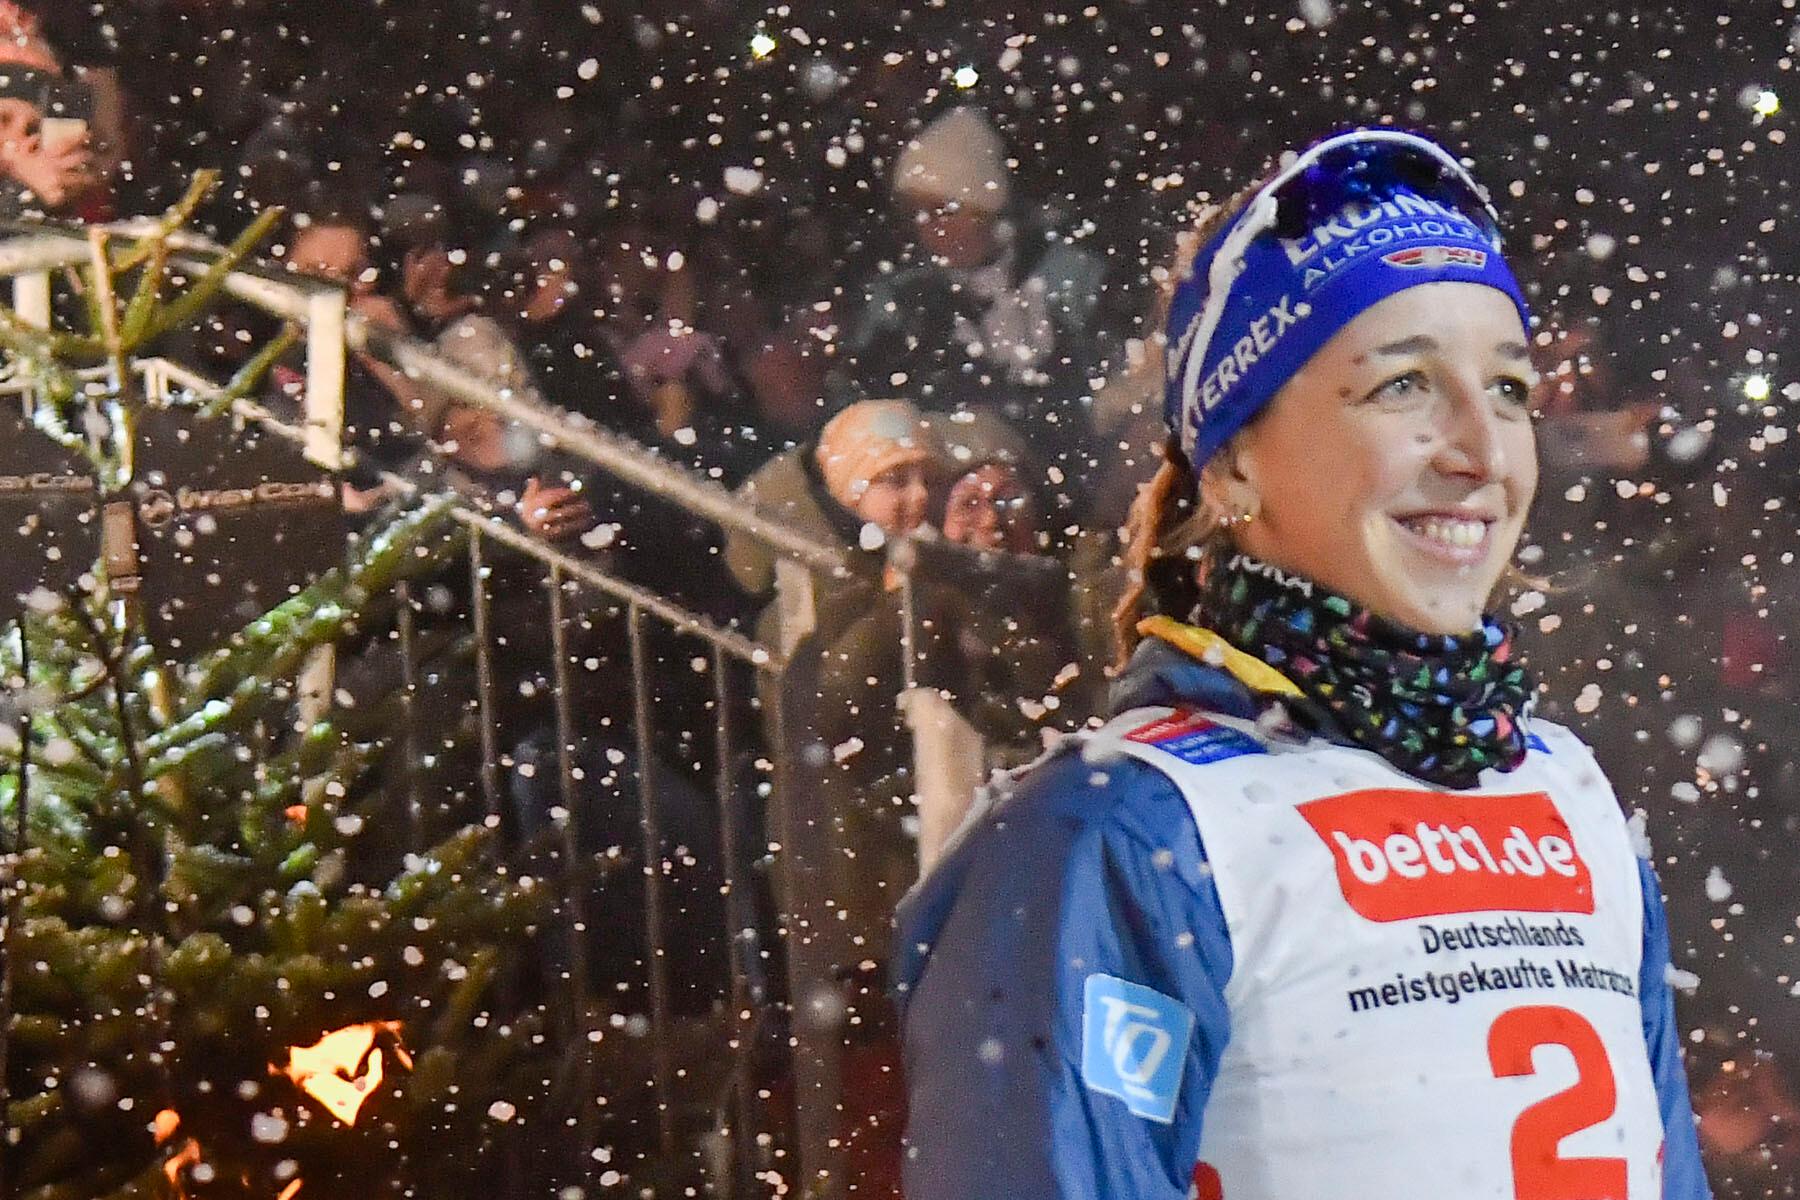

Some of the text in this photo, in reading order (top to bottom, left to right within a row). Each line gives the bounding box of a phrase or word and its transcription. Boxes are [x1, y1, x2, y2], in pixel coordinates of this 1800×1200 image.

[1331, 821, 1577, 885] bett1.de
[1419, 917, 1585, 954] Deutschlands
[1348, 960, 1555, 1012] meistgekaufte
